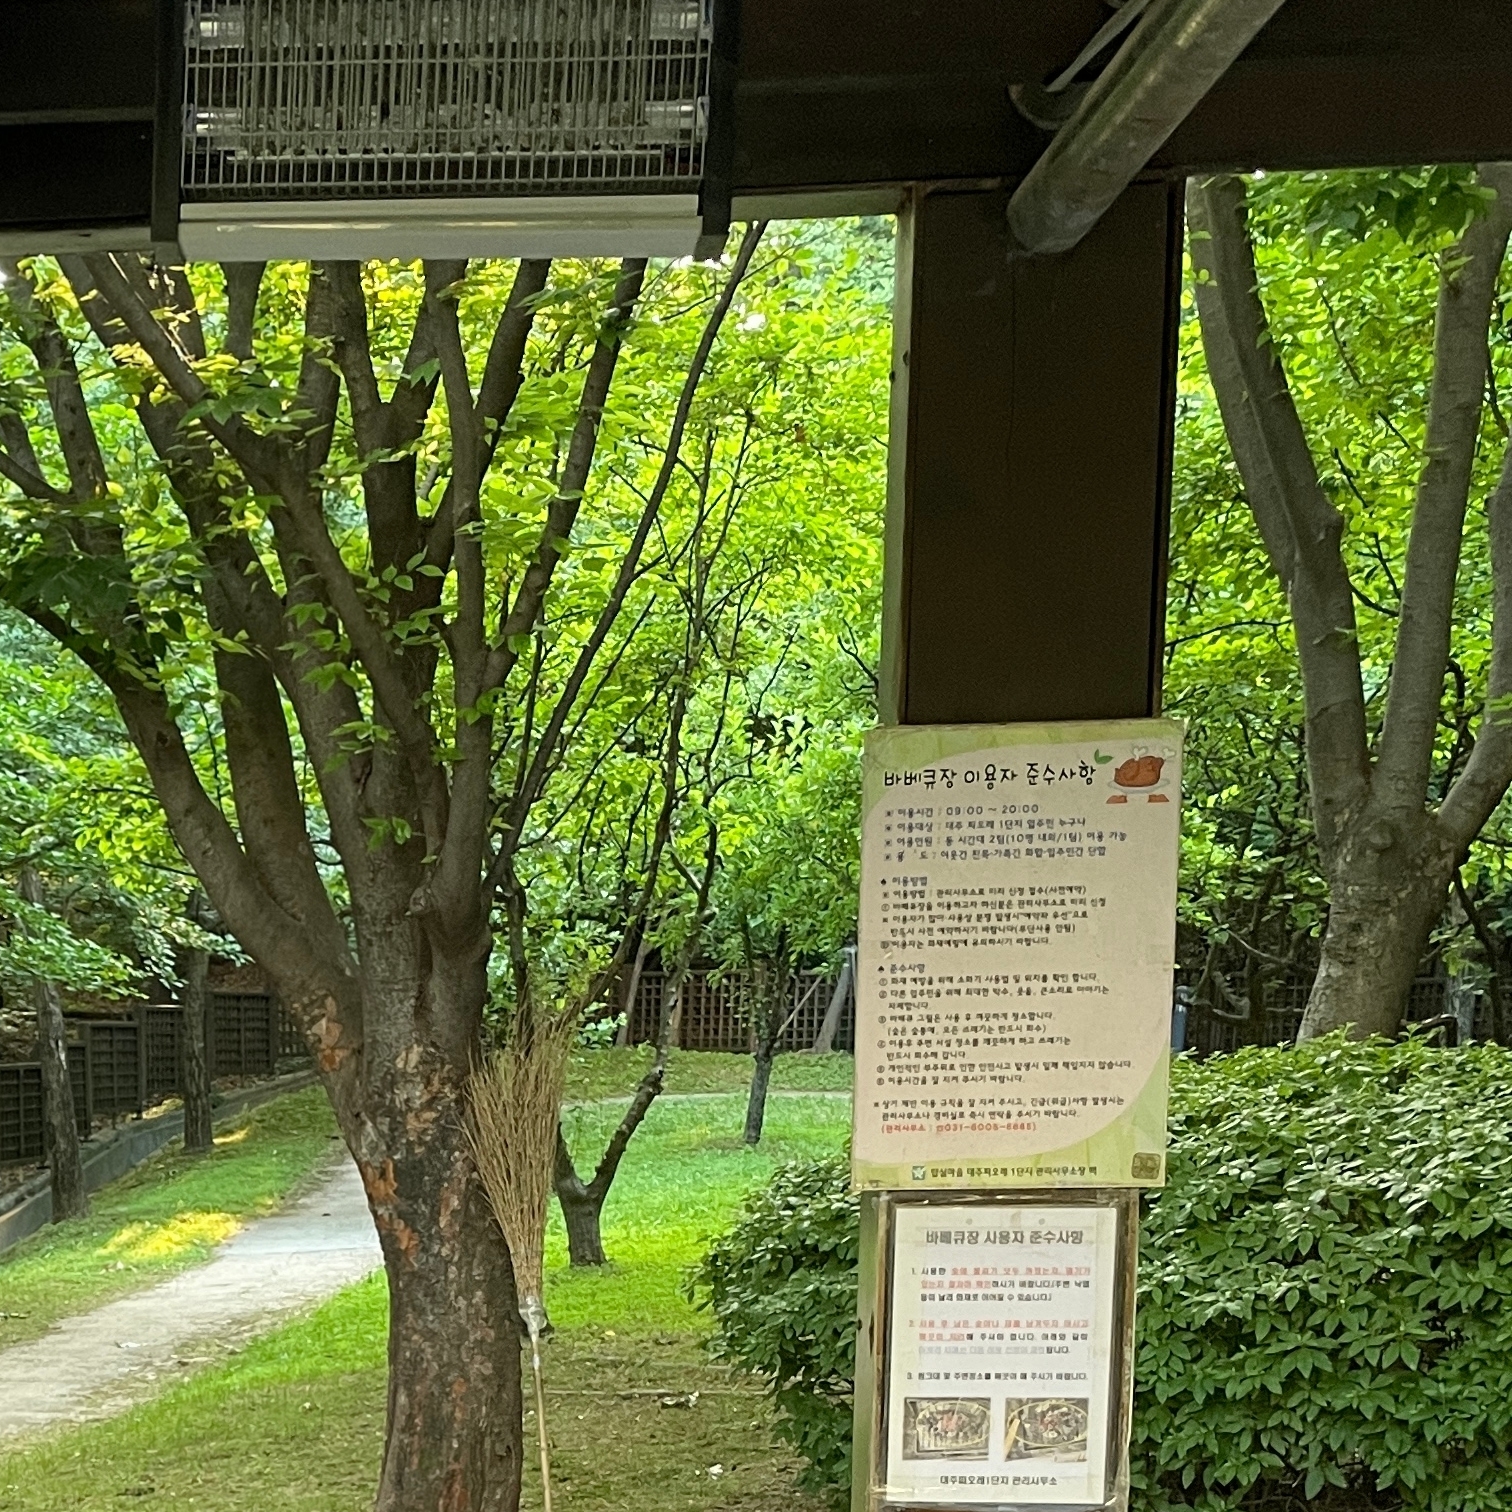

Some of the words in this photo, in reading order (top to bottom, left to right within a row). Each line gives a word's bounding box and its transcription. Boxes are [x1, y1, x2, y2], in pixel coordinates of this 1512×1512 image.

[884, 767, 958, 790] 바베큐장
[964, 763, 1019, 790] 이용자
[1026, 759, 1096, 786] 준수사항
[1001, 804, 1039, 814] 20:00
[983, 1230, 1024, 1245] 사용자
